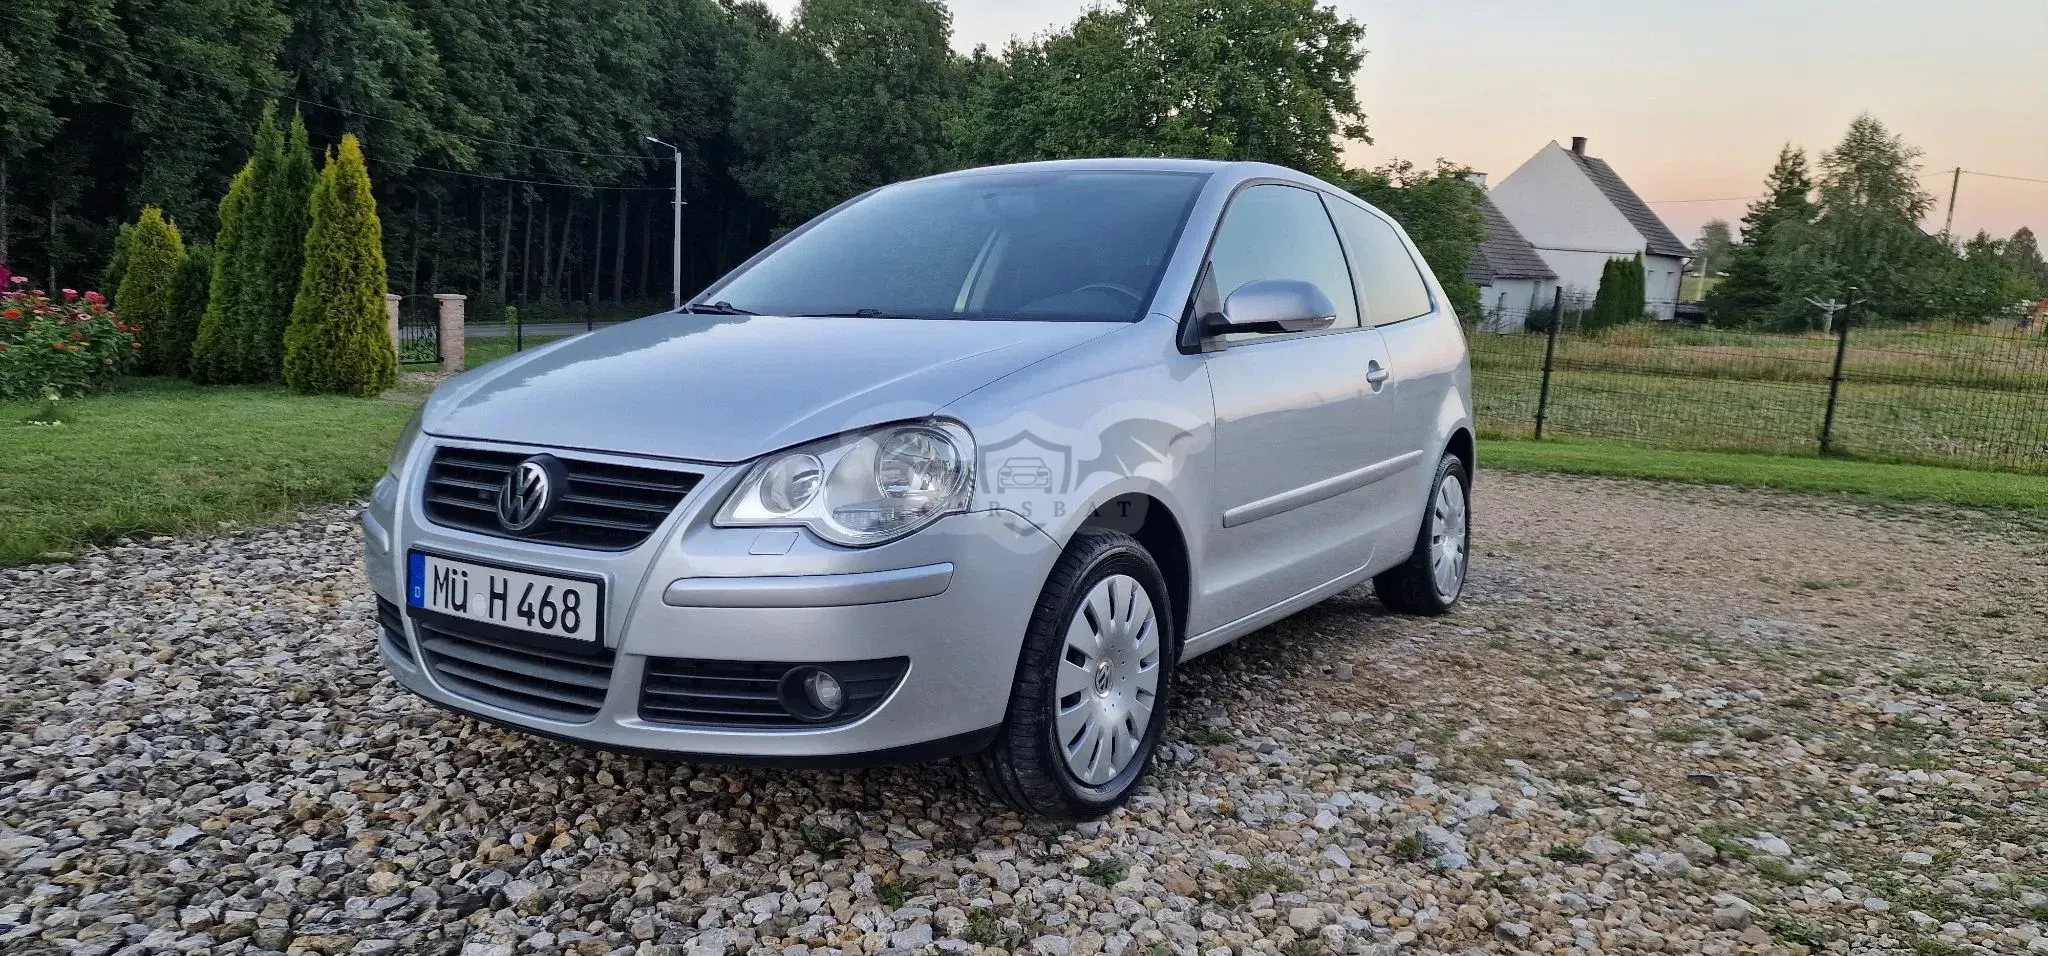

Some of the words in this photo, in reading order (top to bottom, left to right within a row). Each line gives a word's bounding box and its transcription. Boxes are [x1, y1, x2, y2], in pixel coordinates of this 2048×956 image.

[414, 586, 421, 598] D
[488, 575, 508, 621] H
[516, 581, 581, 634] 468
